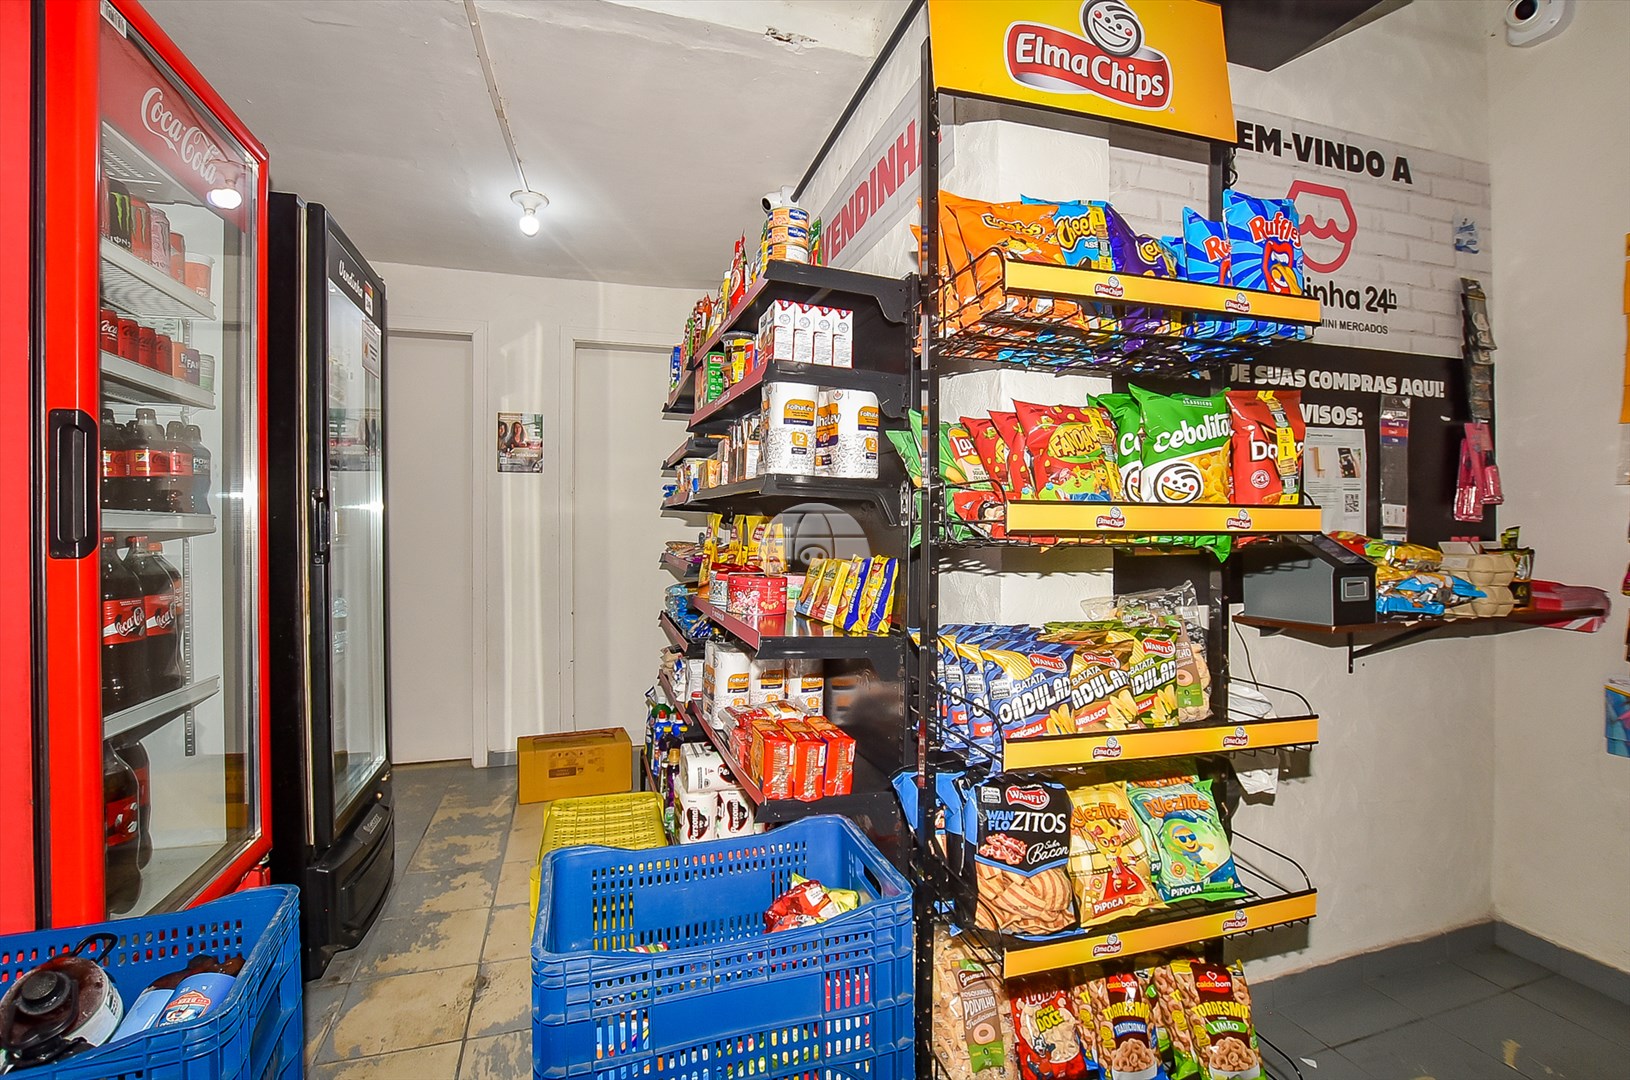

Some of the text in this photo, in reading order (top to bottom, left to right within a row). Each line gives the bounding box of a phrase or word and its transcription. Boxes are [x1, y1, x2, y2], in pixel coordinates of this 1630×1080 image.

[140, 86, 217, 185] Coca-Cola
[1235, 119, 1413, 185] EM-VINDO A
[821, 117, 922, 267] VENDINH
[1306, 276, 1361, 311] inha
[1339, 320, 1389, 335] MERCADOS
[1253, 364, 1307, 388] SUAS
[1308, 370, 1398, 395] COMPRAS
[1399, 377, 1445, 399] AQUI!
[1299, 403, 1364, 426] VISOS:
[1143, 640, 1174, 655] WANFLO
[1071, 665, 1102, 687] BATATA
[999, 676, 1072, 723] ONDULAD
[1075, 707, 1107, 727] URRASCO
[1008, 789, 1046, 804] WANFLO
[689, 806, 699, 841] Personal
[730, 798, 739, 833] Personal
[985, 809, 1015, 821] WAN
[988, 810, 1067, 834] FLO ZITOS
[1026, 842, 1069, 865] Bacon
[1102, 1001, 1151, 1020] TORRESMO
[1190, 1000, 1249, 1019] TORRESMO
[1036, 1010, 1064, 1033] DOCE
[1212, 1020, 1239, 1033] LIMÃO
